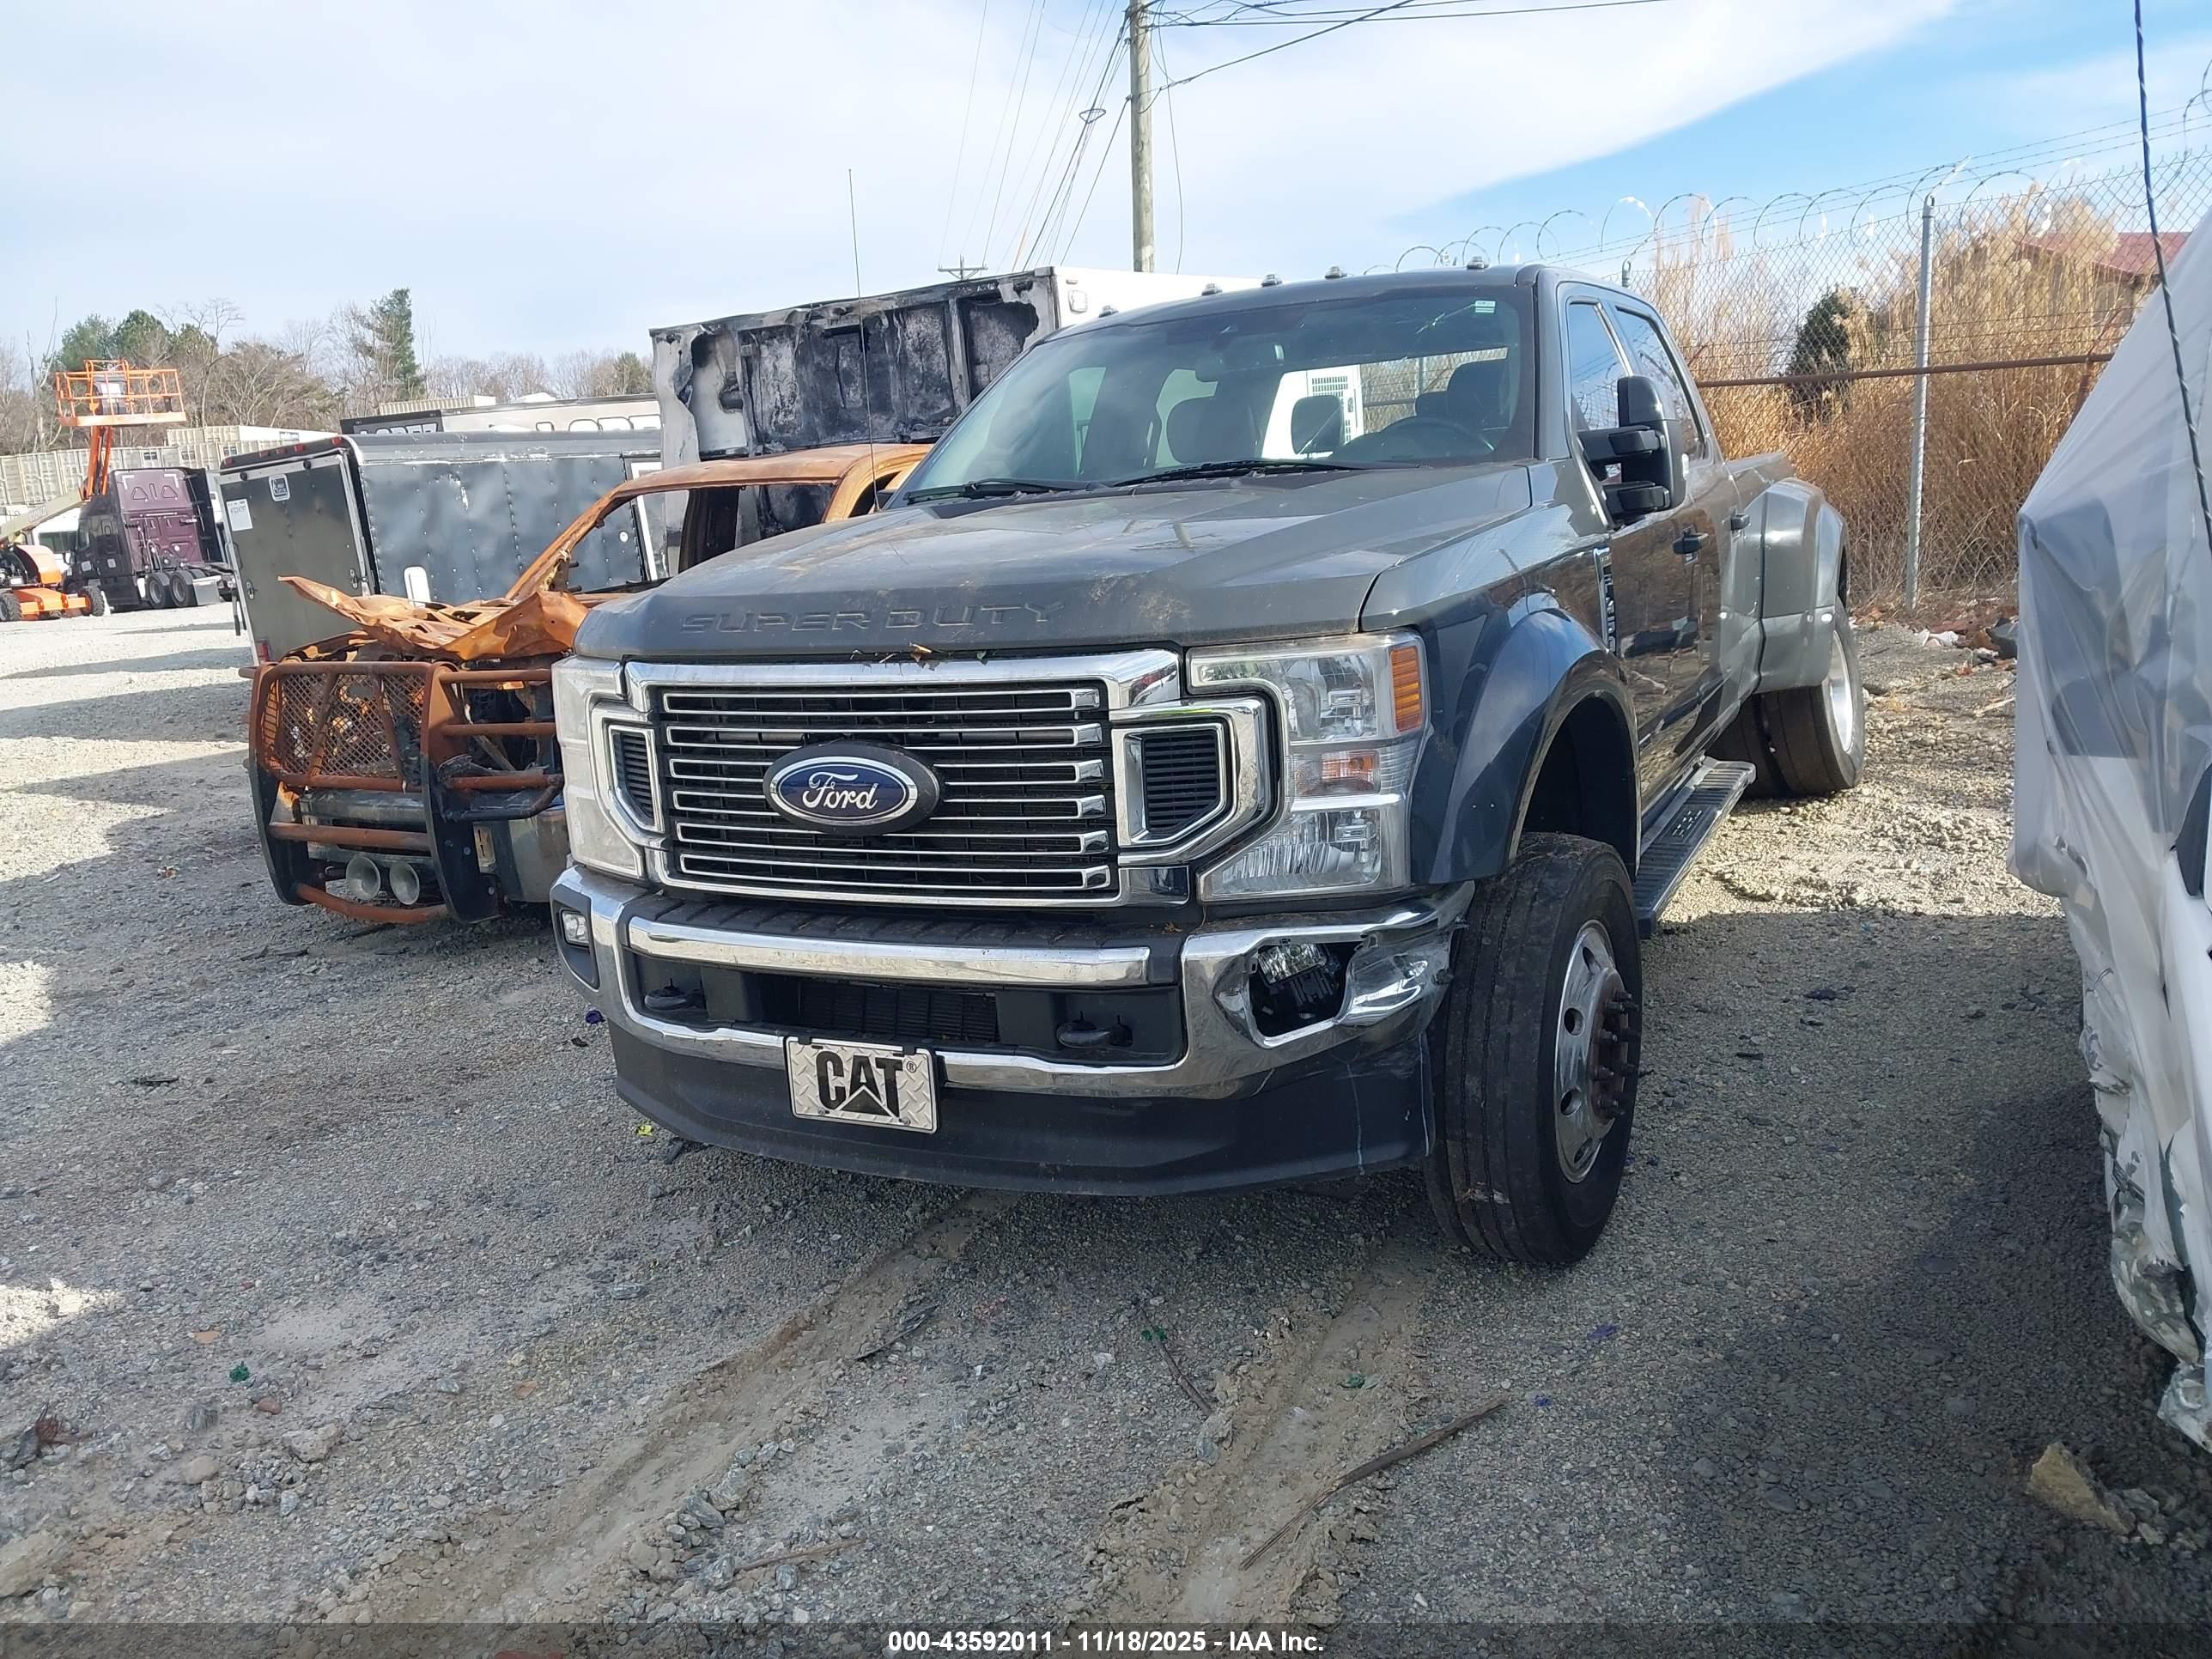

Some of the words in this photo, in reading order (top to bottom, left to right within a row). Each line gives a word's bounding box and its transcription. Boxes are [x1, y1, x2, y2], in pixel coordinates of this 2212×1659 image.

[681, 612, 871, 634] SUPER
[885, 601, 1065, 629] DUTY
[802, 771, 879, 810] Ford
